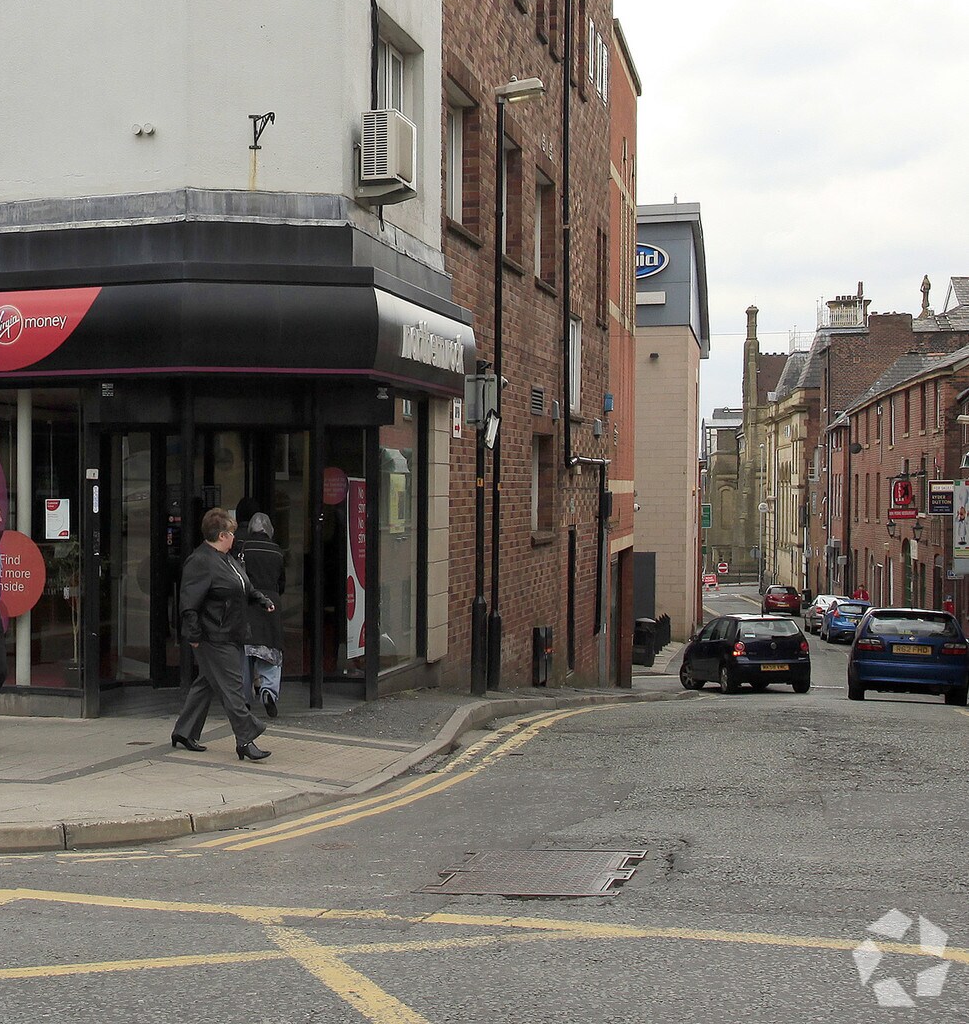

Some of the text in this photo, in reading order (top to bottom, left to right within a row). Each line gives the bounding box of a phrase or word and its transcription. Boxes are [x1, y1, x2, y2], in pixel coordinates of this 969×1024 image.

[24, 316, 67, 330] money
[5, 570, 31, 579] more
[0, 581, 24, 592] nside
